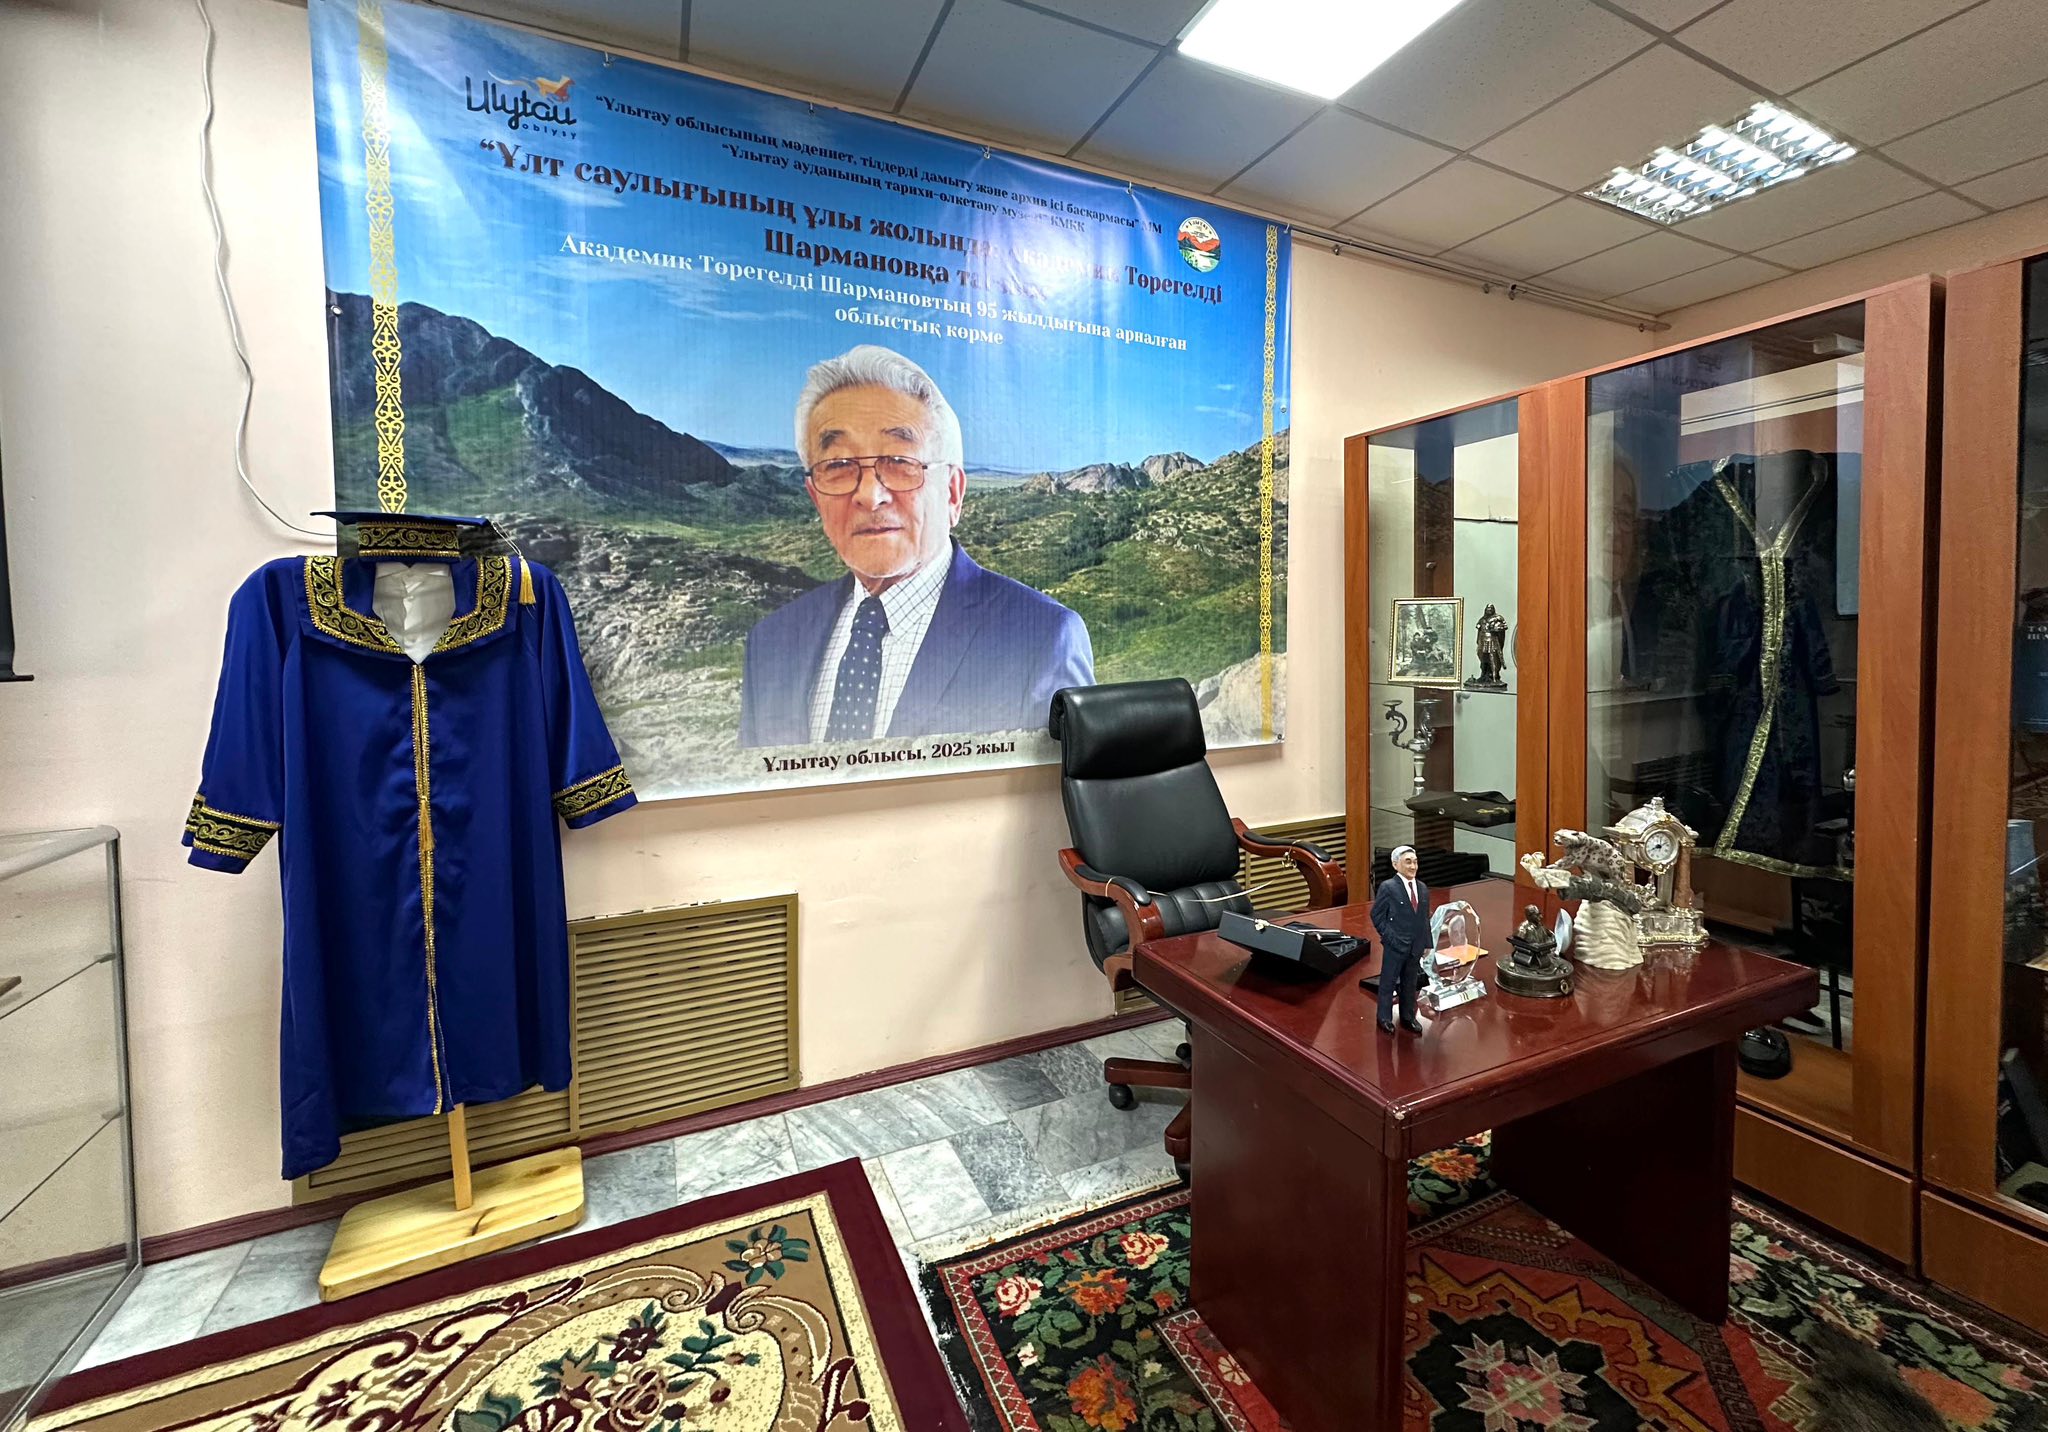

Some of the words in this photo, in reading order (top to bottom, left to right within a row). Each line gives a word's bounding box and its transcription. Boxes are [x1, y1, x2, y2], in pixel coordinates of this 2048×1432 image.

[465, 75, 577, 130] Ulytau
[522, 123, 577, 140] oblysy
[675, 116, 778, 149] облысының
[781, 137, 857, 166] мәдениет,
[860, 157, 918, 179] тілдерді
[921, 171, 974, 192] дамыту
[976, 184, 1009, 199] және
[1011, 193, 1047, 209] архив
[1050, 199, 1064, 212] ісі
[793, 159, 883, 190] ауданының
[885, 181, 999, 215] тарихи-өлкетану
[574, 161, 797, 224] саулығының
[801, 205, 863, 232] ұлы
[1125, 265, 1223, 306] Төрегелді
[764, 228, 950, 285] Шармановқа
[560, 234, 692, 271] Академик
[699, 254, 814, 293] Төрегелді
[820, 274, 972, 318] Шармановтың
[977, 300, 998, 319] 95
[1002, 308, 1111, 338] жылдығына
[1115, 327, 1187, 351] арналған
[835, 307, 942, 338] облыстық
[946, 325, 1004, 345] көрме
[762, 754, 841, 772] Ұлытау
[846, 749, 927, 767] облысы,
[931, 741, 972, 759] 2025
[976, 741, 1015, 755] жыл
